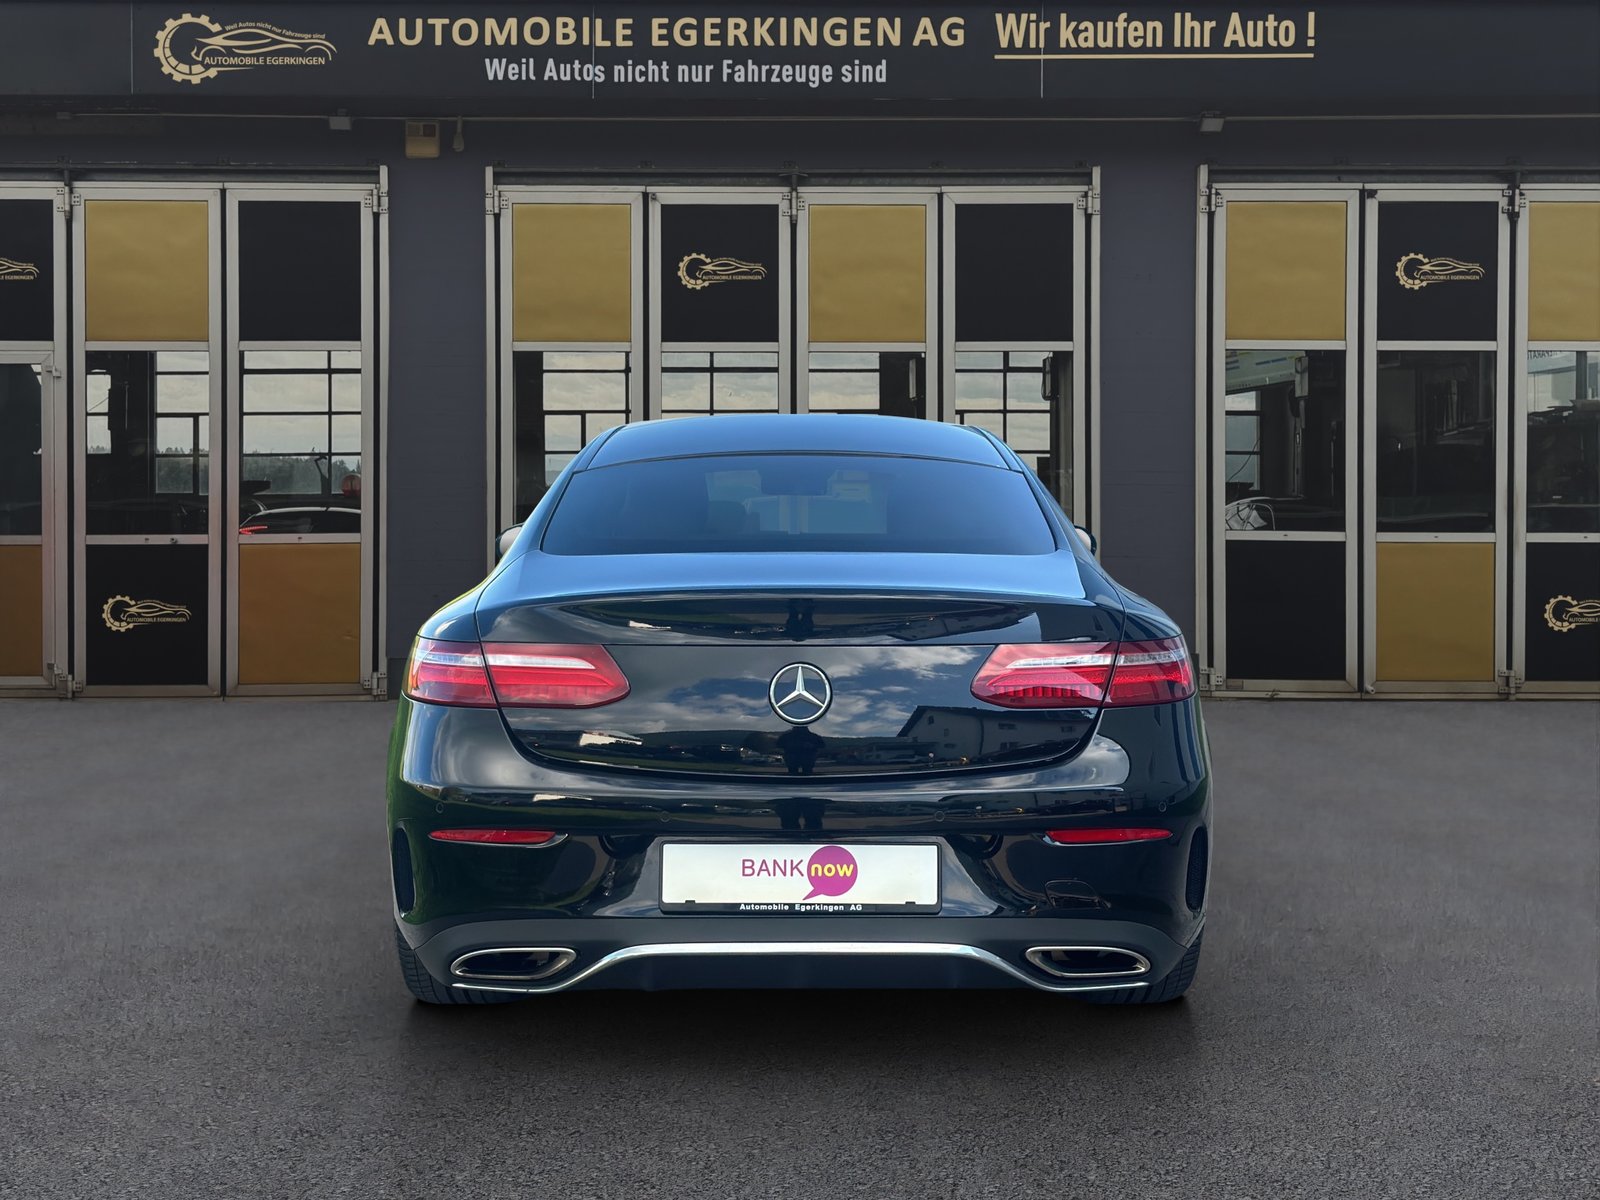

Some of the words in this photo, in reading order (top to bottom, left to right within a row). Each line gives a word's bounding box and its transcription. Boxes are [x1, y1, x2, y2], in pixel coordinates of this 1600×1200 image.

[224, 23, 238, 31] Weil
[256, 22, 272, 30] nicht
[271, 26, 282, 34] nur
[281, 29, 312, 39] Fahrzeuge
[367, 16, 634, 48] AUTOMOBILE
[651, 16, 902, 48] EGERKINGEN
[912, 16, 966, 48] AG
[994, 12, 1051, 49] Wir
[1059, 12, 1163, 49] kaufen
[1173, 12, 1217, 48] Ihr
[1223, 12, 1296, 48] Auto
[203, 56, 265, 66] AUTOMOBILE
[266, 56, 326, 66] EGERKINGEN
[485, 58, 536, 82] Weil
[543, 58, 606, 83] Autos
[613, 59, 670, 84] nicht
[677, 62, 714, 85] nur
[722, 59, 833, 88] Fahrzeuge
[841, 59, 887, 84] sind
[741, 859, 805, 877] BANK
[810, 863, 854, 877] now
[739, 903, 790, 911] Automobile
[794, 903, 844, 912] Egerkingen
